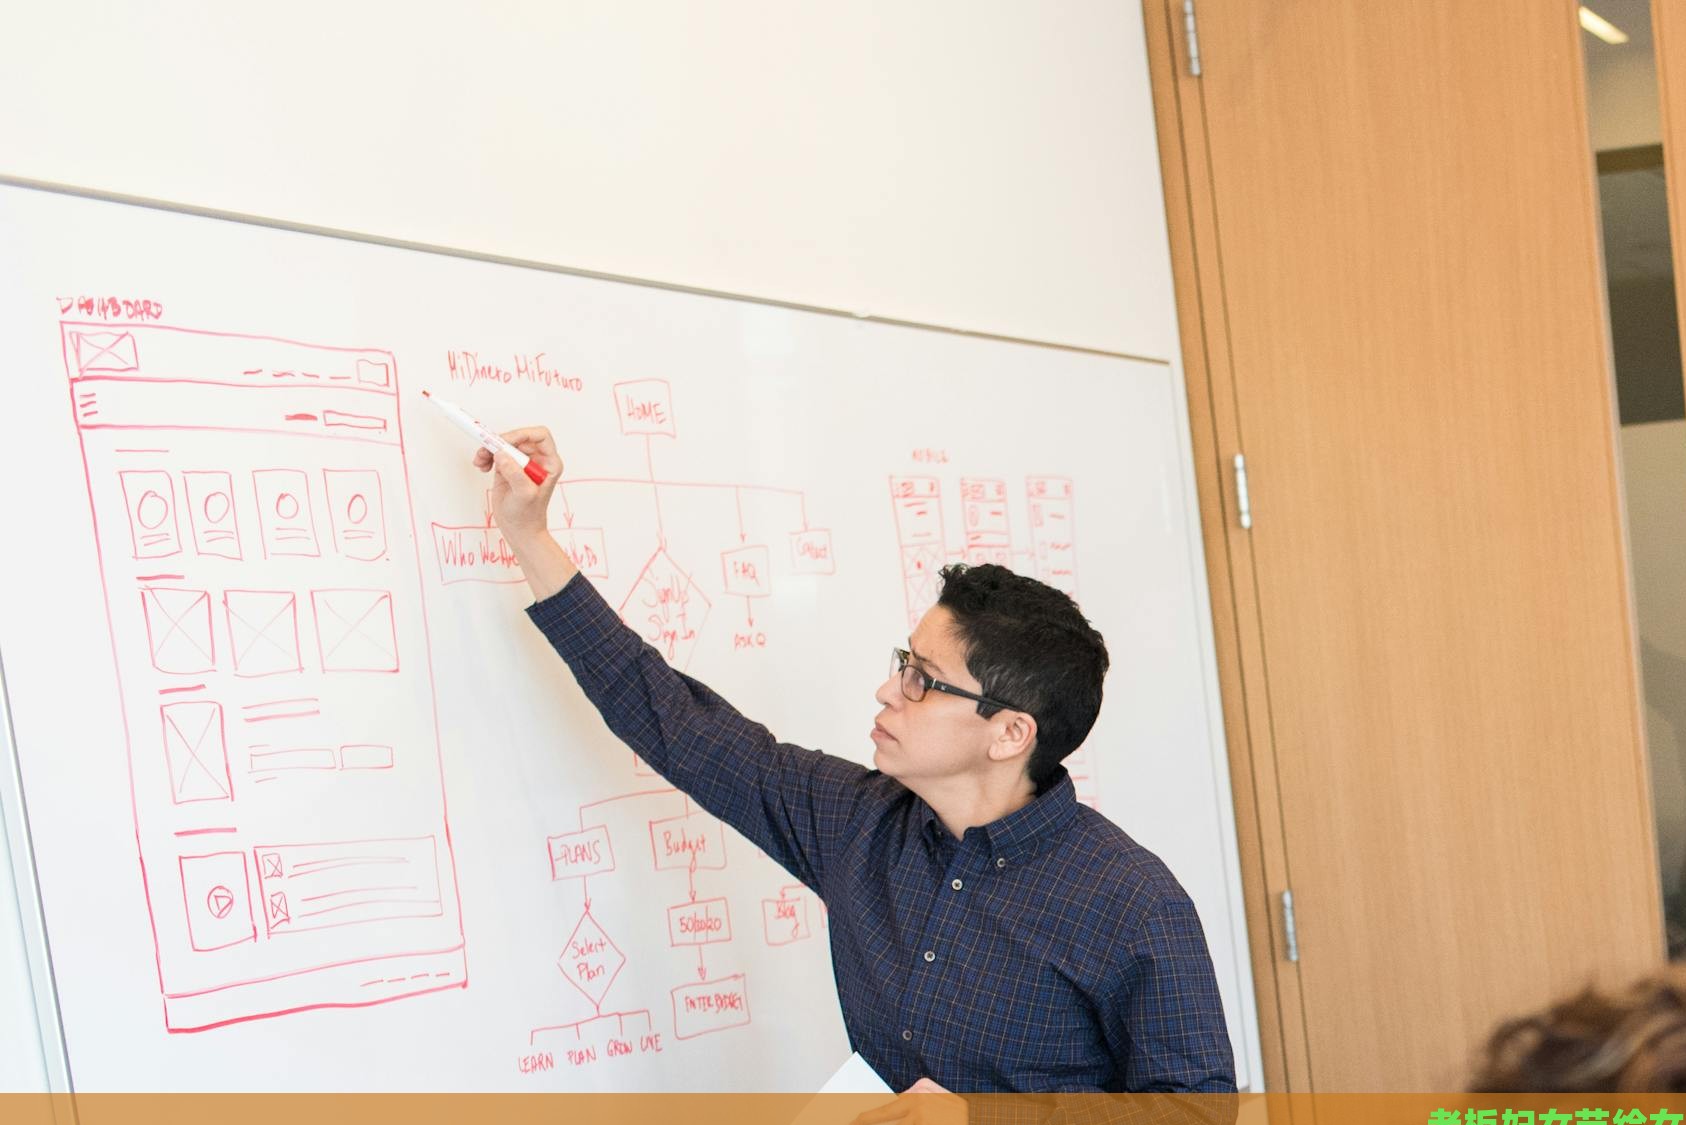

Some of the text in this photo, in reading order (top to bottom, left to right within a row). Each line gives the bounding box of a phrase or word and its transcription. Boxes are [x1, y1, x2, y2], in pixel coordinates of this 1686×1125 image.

[625, 394, 668, 424] HOME
[517, 1052, 555, 1075] LEARN
[566, 1046, 597, 1067] PLAN
